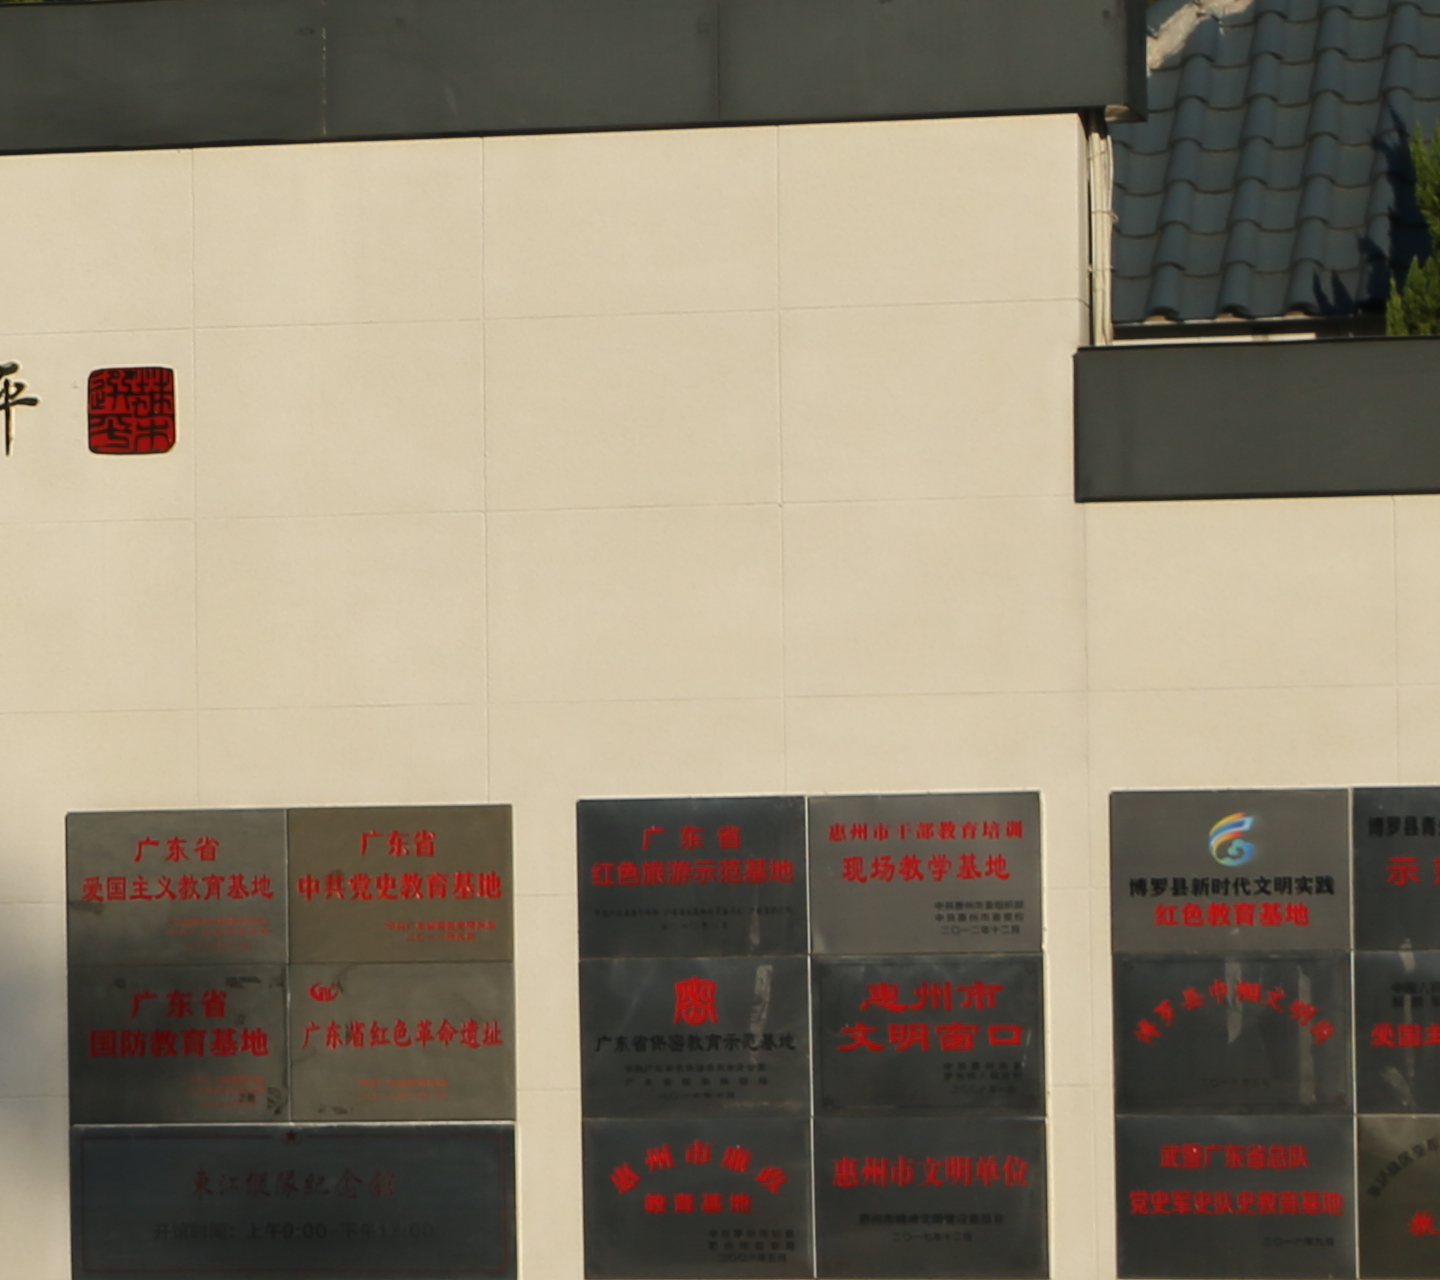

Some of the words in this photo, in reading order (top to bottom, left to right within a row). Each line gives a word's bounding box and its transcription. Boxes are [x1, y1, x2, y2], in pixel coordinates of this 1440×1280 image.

[360, 829, 437, 858] 广东省
[642, 825, 741, 851] 广东省
[828, 820, 1024, 842] 惠州市干部教育培训
[133, 836, 220, 863] 广东省
[591, 858, 794, 887] 红色旅游示范基地
[841, 852, 1011, 883] 现场教学基地
[81, 874, 274, 902] 爱国主义教育基地
[297, 871, 503, 901] 中共党史教育基地
[1129, 876, 1335, 897] 博罗县新时代文明实践
[1154, 902, 1310, 927] 红色教育基地
[131, 989, 227, 1019] 广东省
[860, 980, 1003, 1012] 惠州市
[89, 1028, 270, 1057] 国防教育基地
[302, 1019, 504, 1050] 广东省红色革命遗址
[838, 1021, 1023, 1052] 文明窗口
[1159, 1143, 1311, 1169] 武警广东省总队
[832, 1156, 1030, 1189] 惠州市文明单位
[644, 1193, 752, 1213] 教育基地
[1129, 1190, 1344, 1216] 党史军史队史教育基地
